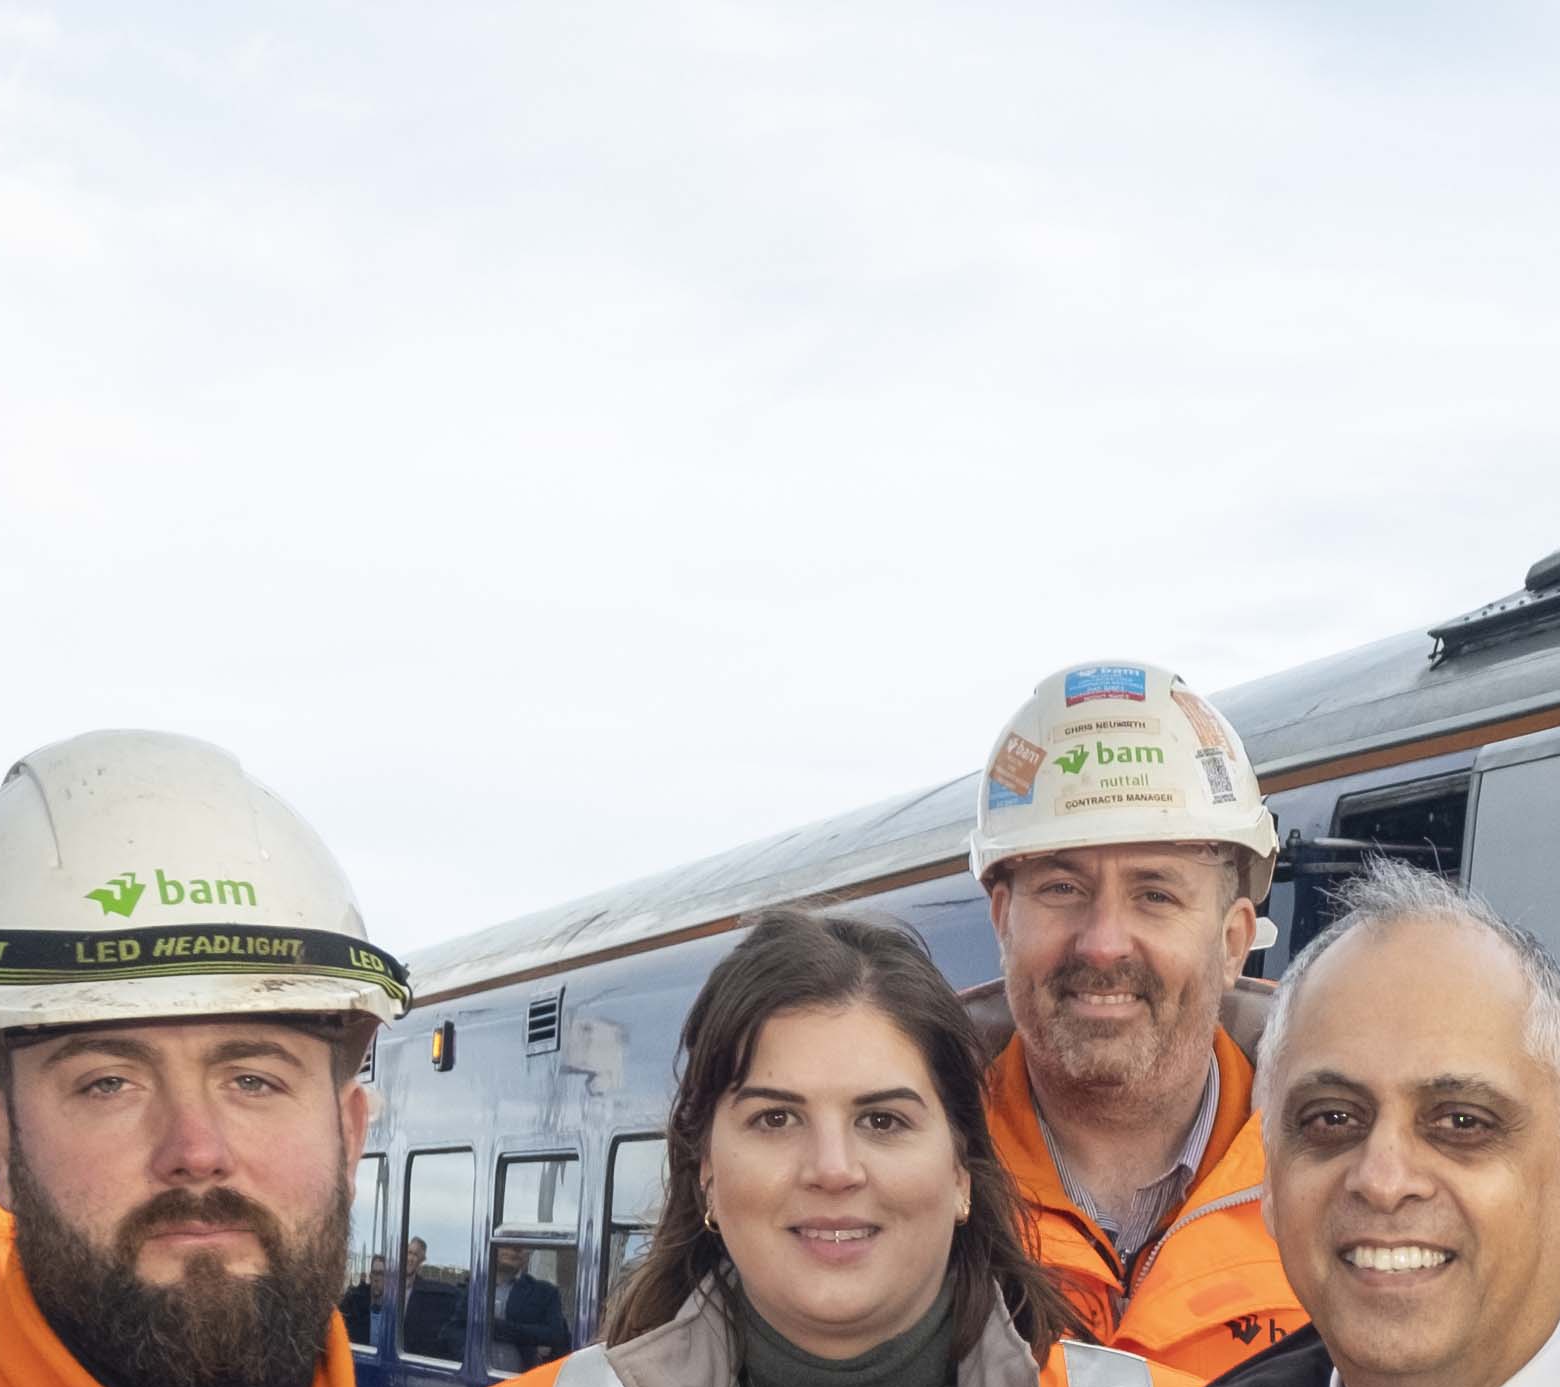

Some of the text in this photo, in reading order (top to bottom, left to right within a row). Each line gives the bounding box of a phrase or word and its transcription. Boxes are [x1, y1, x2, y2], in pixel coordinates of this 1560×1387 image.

[1064, 723, 1093, 735] CHRIS
[1096, 741, 1164, 765] bam
[1100, 773, 1149, 788] nuttall
[154, 869, 257, 907] bam
[75, 940, 141, 963] LED
[152, 936, 304, 958] HEADLIGHT
[349, 946, 383, 973] LED
